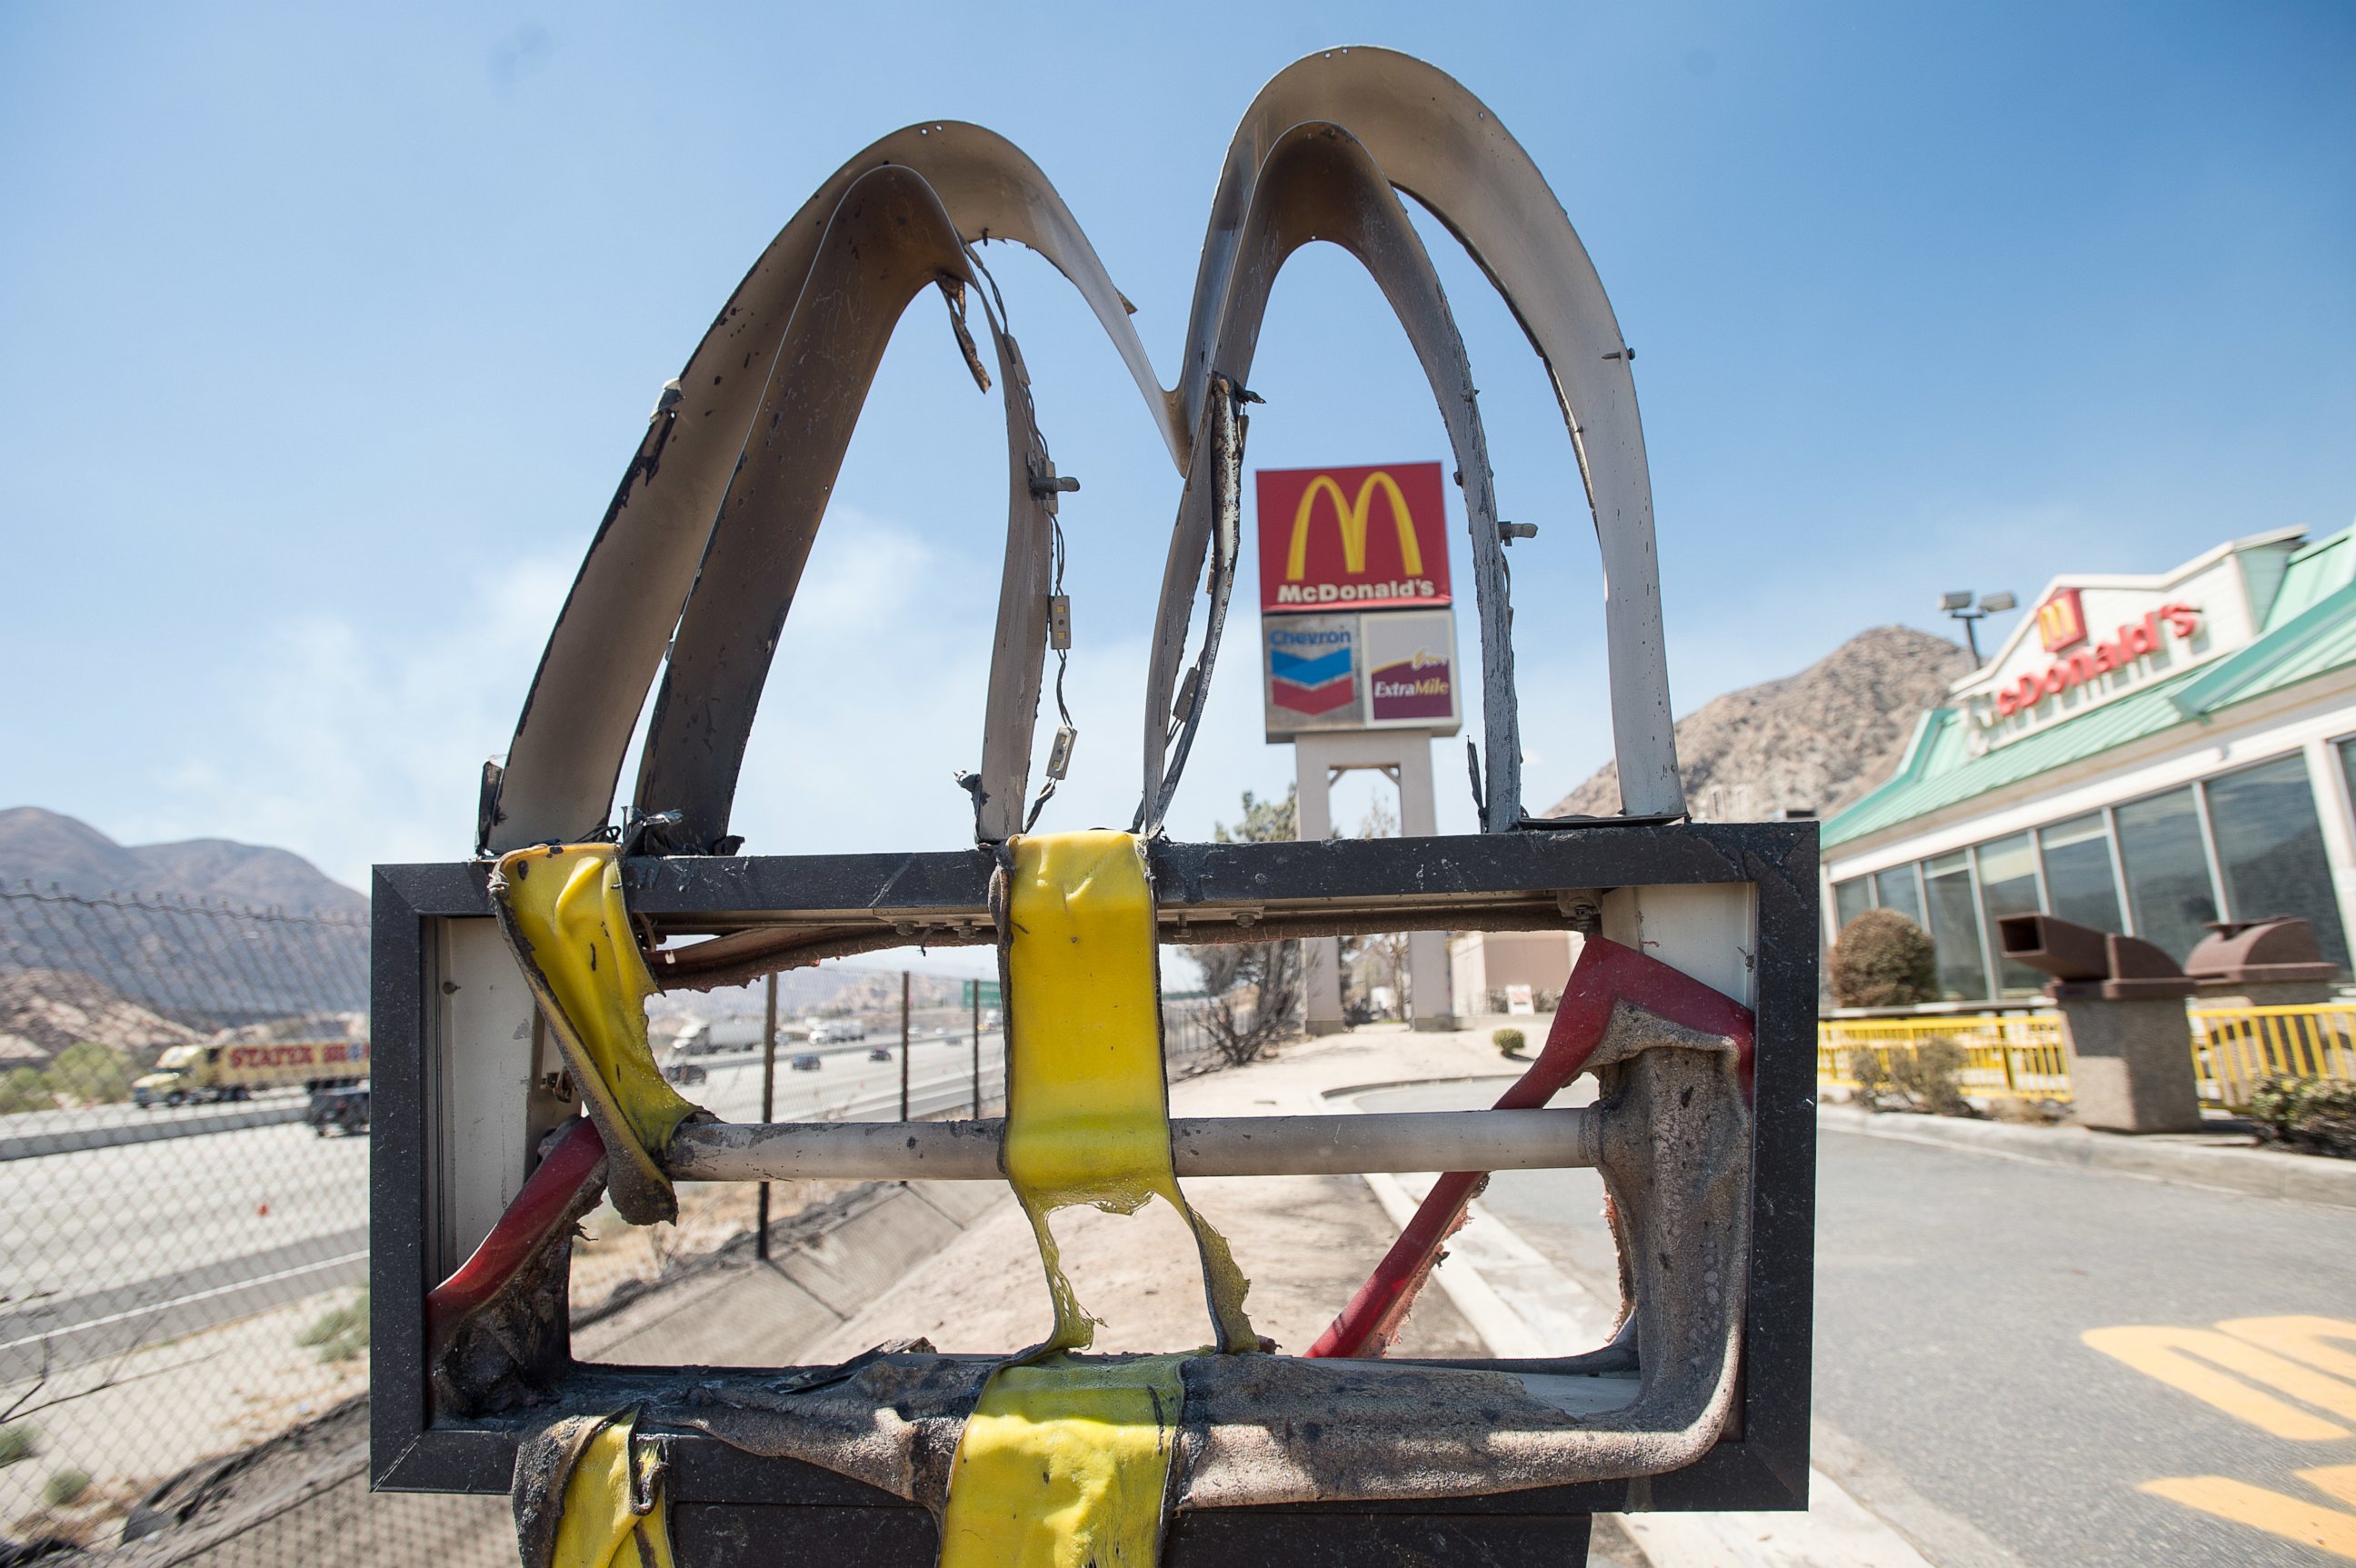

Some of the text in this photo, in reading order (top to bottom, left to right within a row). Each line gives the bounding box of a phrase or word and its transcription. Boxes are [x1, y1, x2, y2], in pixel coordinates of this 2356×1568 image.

[1278, 579, 1435, 603] McDonald's
[1270, 630, 1352, 646] Chevron
[1374, 677, 1449, 698] ExtraMile
